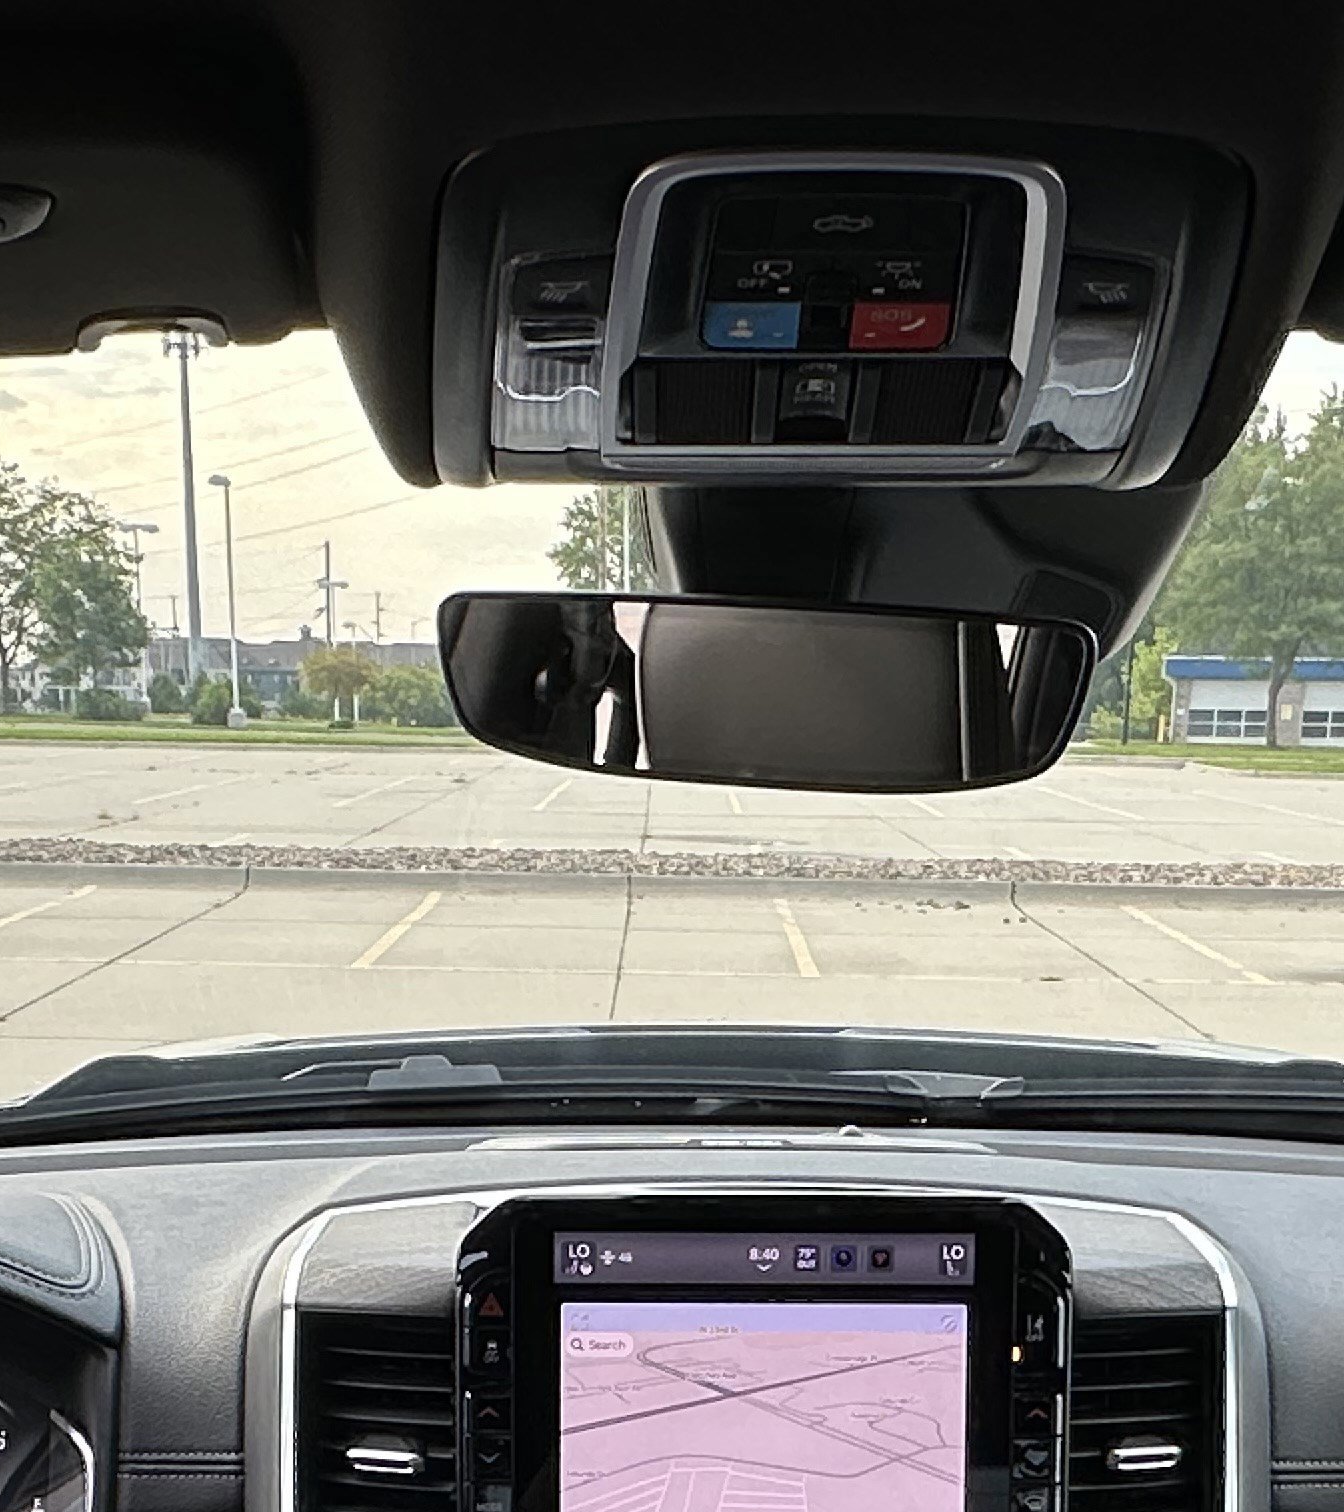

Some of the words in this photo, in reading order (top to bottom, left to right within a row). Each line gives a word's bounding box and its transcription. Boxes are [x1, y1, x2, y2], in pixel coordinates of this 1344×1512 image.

[568, 1243, 591, 1259] LO
[942, 1244, 965, 1260] LO
[588, 1339, 626, 1352] Search
